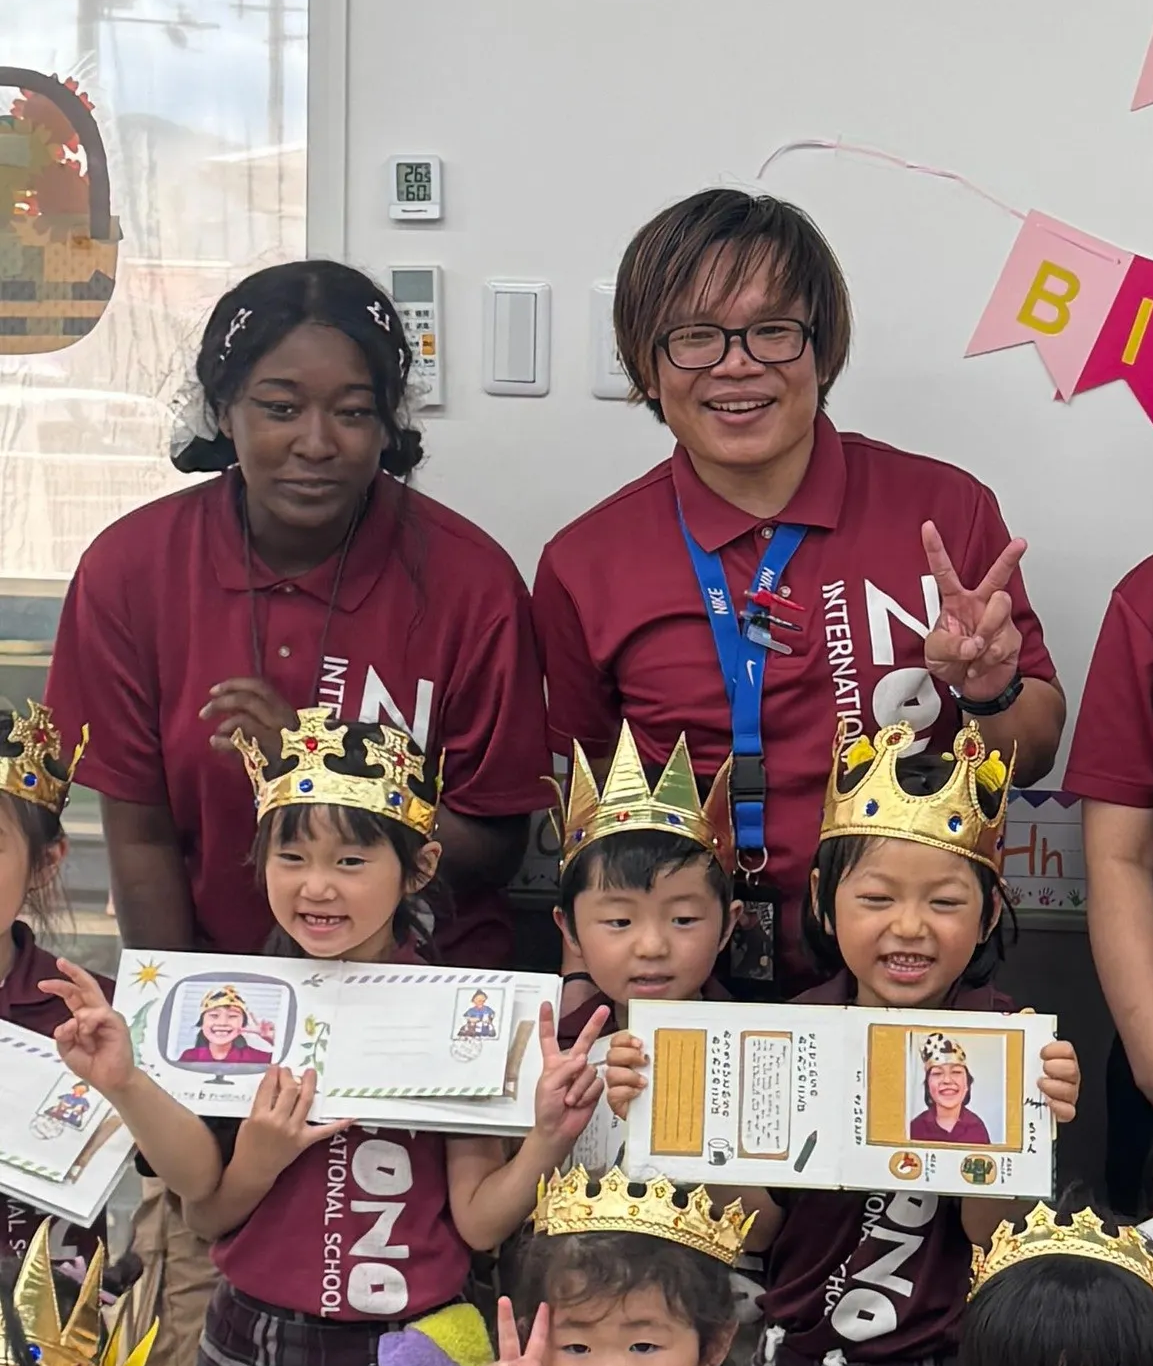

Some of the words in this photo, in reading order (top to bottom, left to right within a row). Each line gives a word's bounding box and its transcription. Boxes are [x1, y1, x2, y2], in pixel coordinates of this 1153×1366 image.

[708, 587, 729, 615] NIKE
[757, 566, 776, 592] NIK
[347, 1128, 414, 1315] ONO
[321, 1233, 343, 1318] SCHOOL
[831, 1191, 939, 1342] ONO
